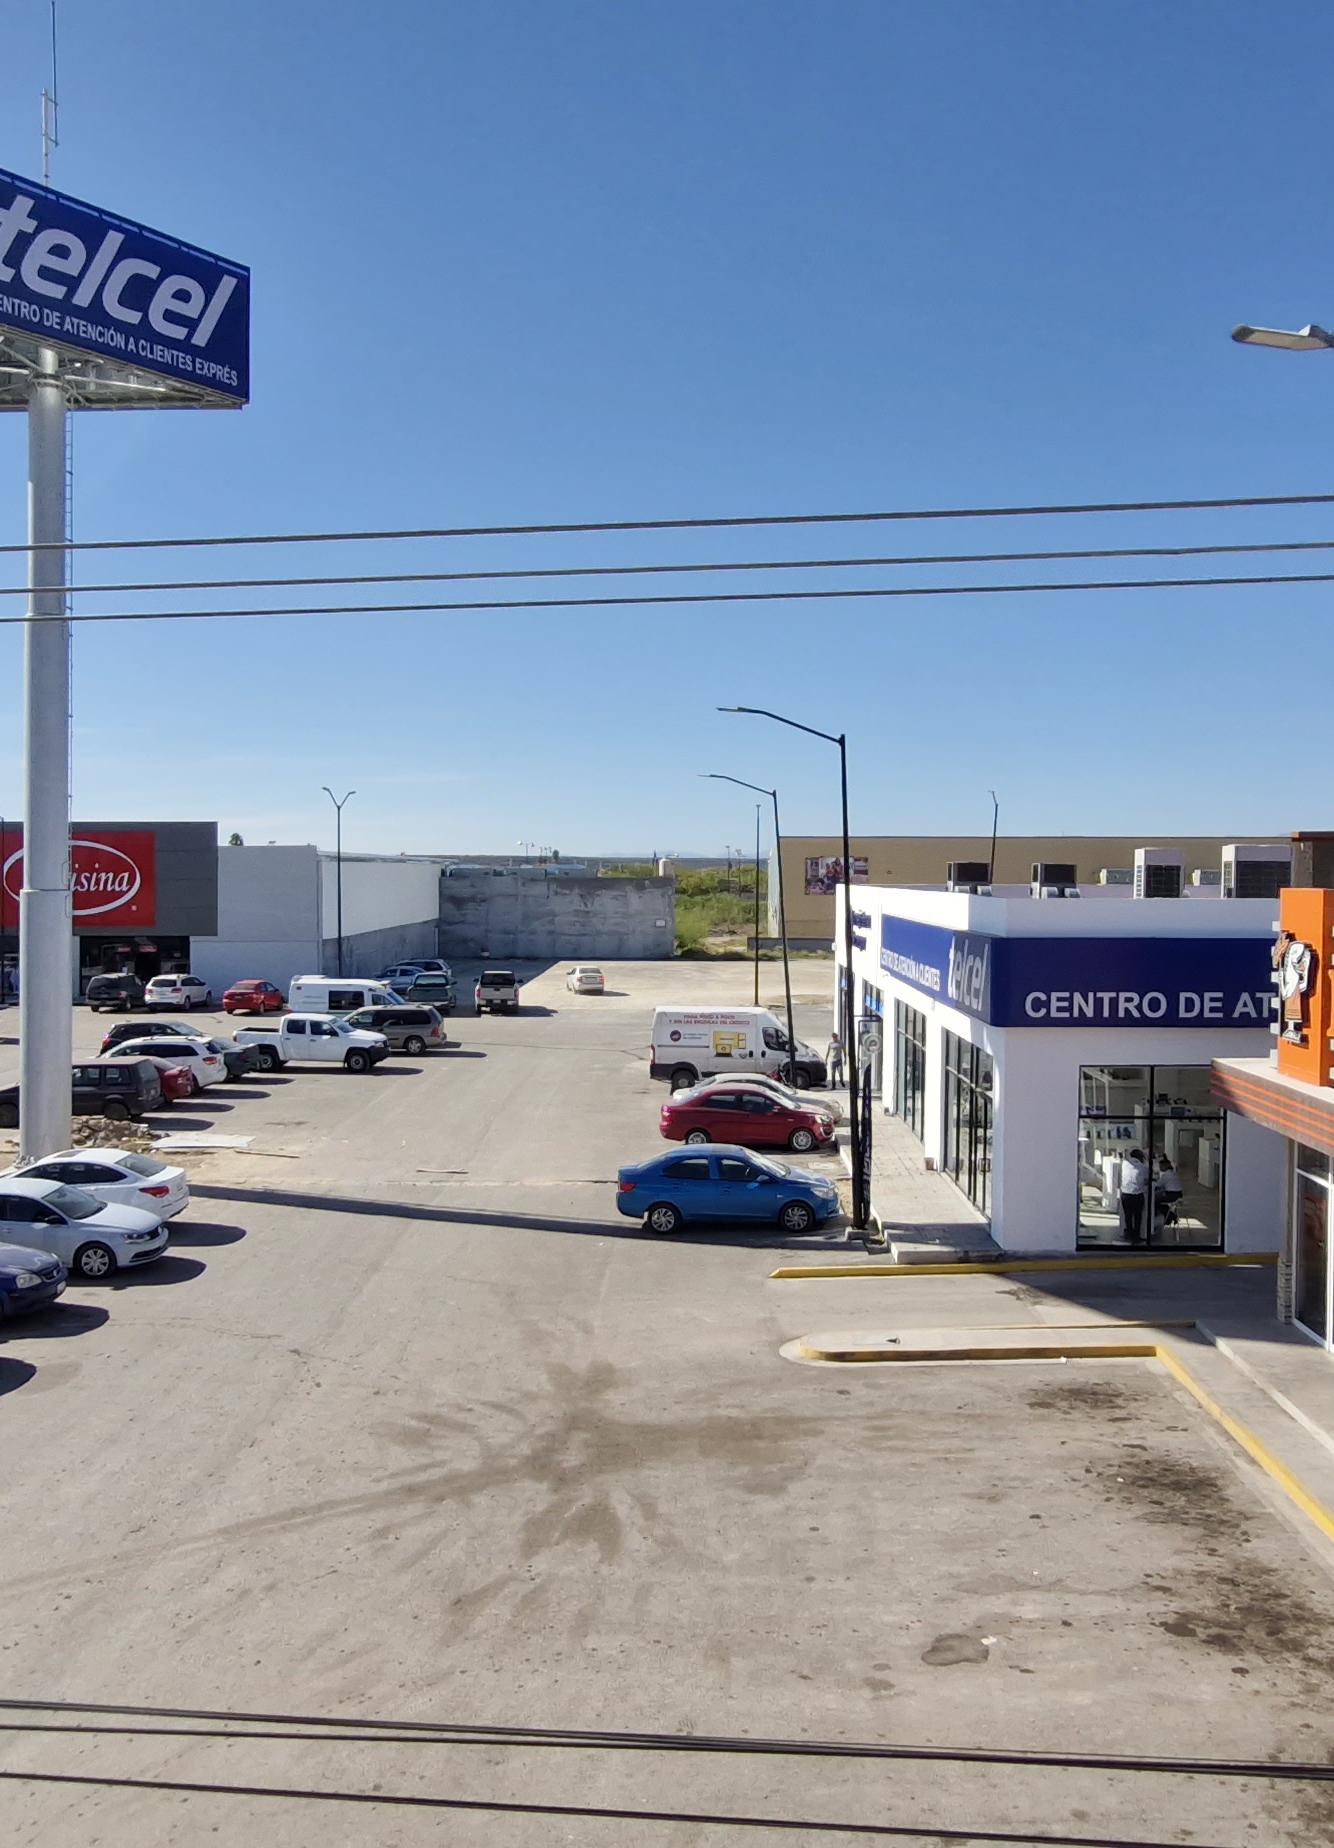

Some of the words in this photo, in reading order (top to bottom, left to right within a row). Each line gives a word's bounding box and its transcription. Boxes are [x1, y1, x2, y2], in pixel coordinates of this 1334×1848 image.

[43, 307, 61, 330] DE
[63, 315, 125, 350] ATENCIÓN
[127, 336, 137, 354] A
[138, 339, 193, 372] CLIENTES
[195, 357, 238, 387] EXPRÉS
[947, 935, 988, 1012] telcel
[1024, 991, 1167, 1018] CENTRO
[1178, 992, 1224, 1018] DE
[1232, 992, 1277, 1018] AT
